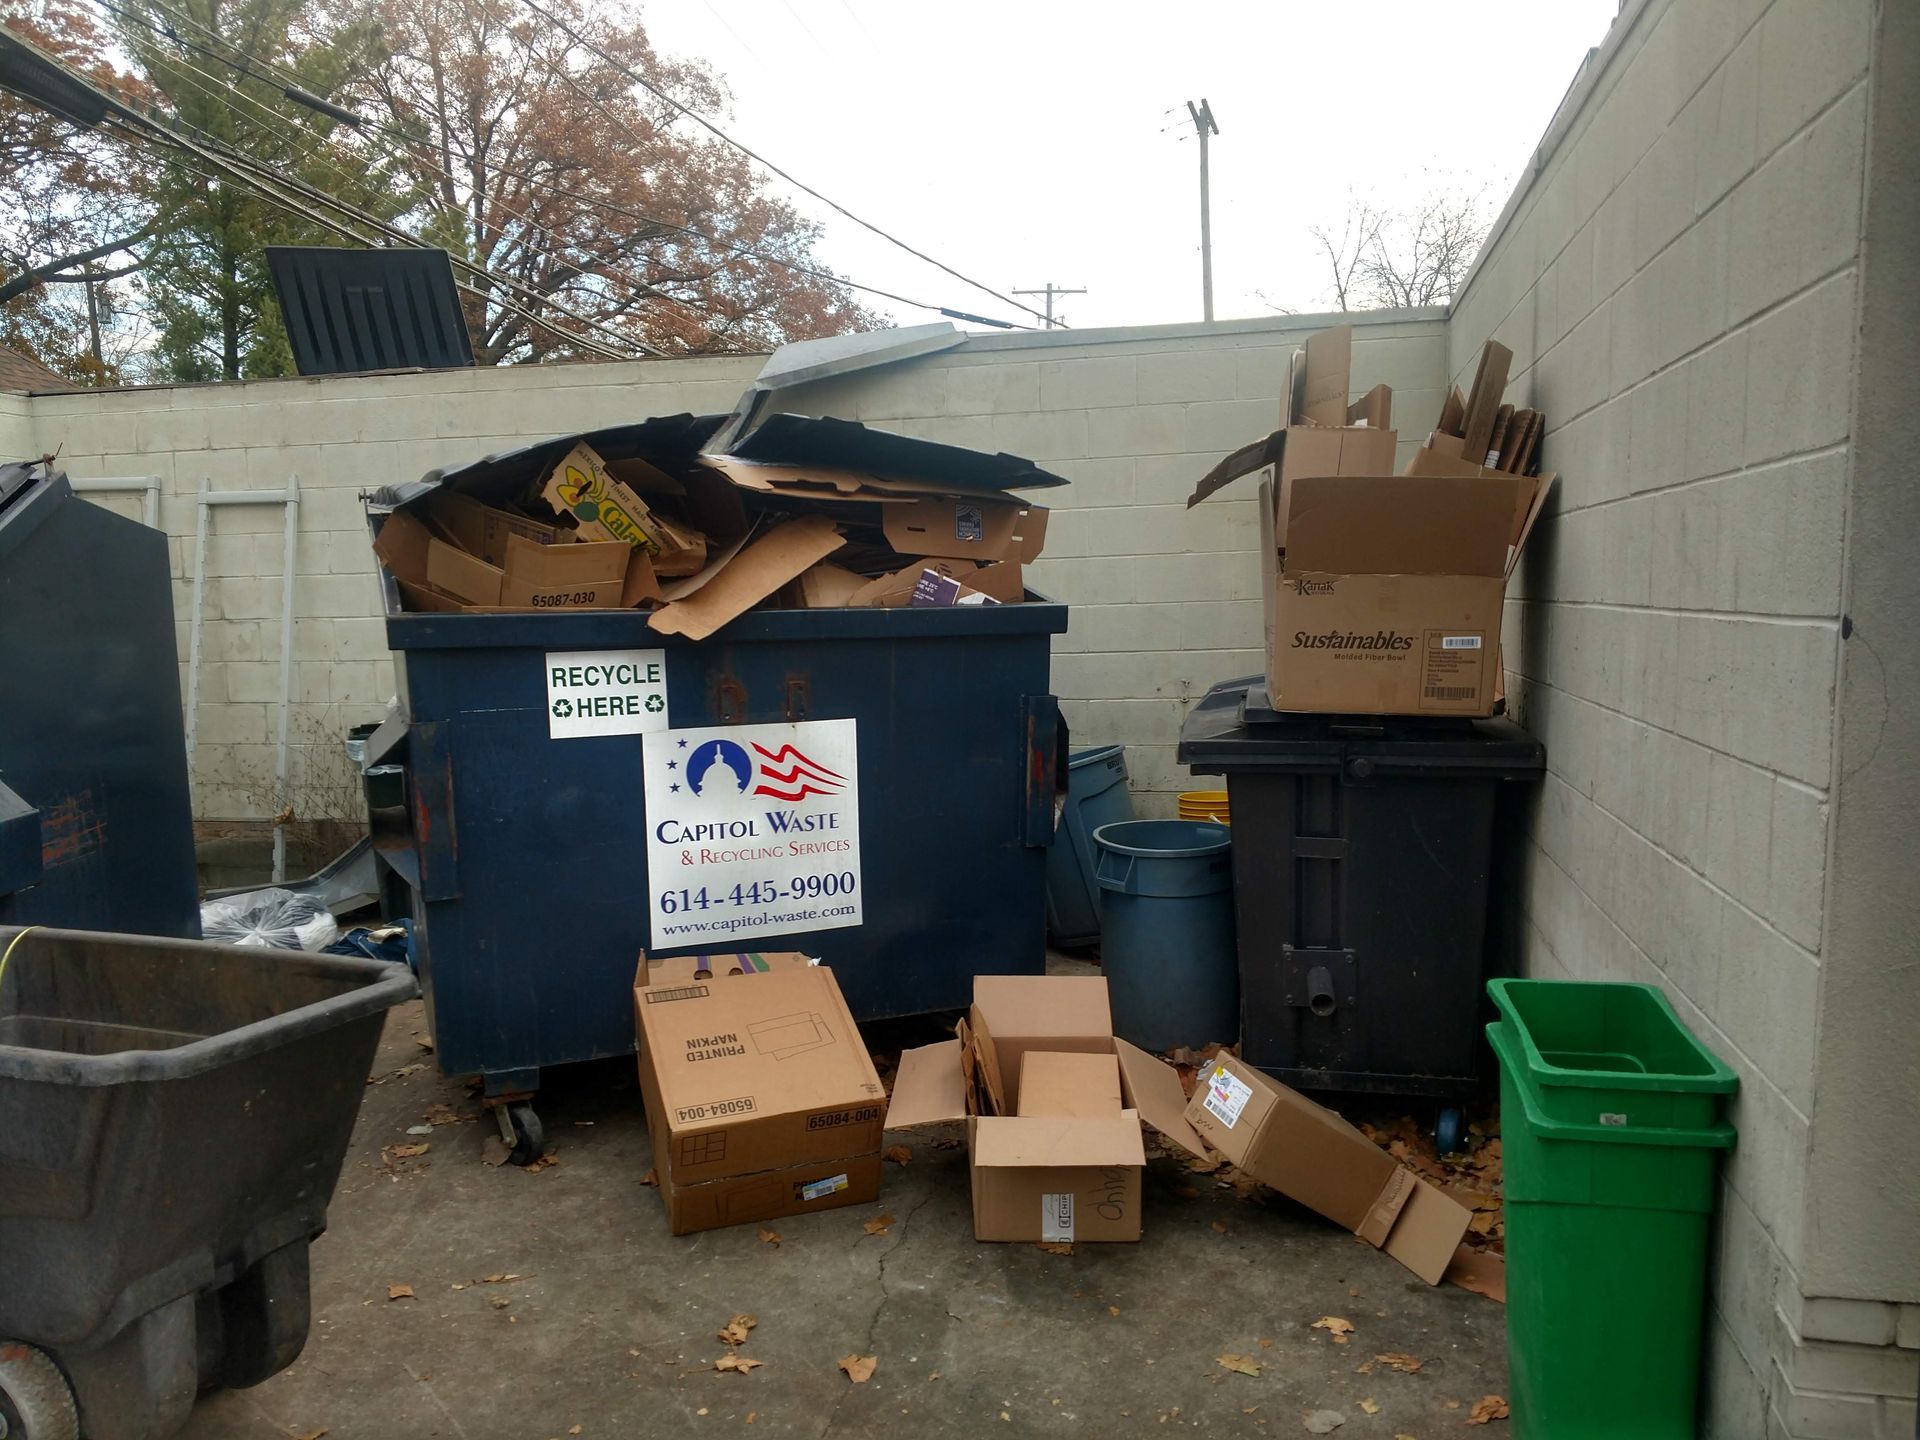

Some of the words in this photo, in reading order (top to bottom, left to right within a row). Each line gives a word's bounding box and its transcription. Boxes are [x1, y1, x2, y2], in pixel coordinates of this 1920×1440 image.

[611, 483, 631, 503] FINEST
[632, 505, 647, 521] HASS
[532, 591, 596, 607] 65087-030
[1291, 630, 1413, 650] Sustainables
[1334, 653, 1363, 661] Molded
[1365, 653, 1385, 661] Fiber
[551, 664, 661, 688] RECYCLE
[577, 695, 640, 718] HERE
[656, 819, 760, 845] CAPITOL
[765, 810, 840, 833] WASTE
[681, 850, 694, 866] &
[700, 846, 783, 865] RECYCLING
[789, 839, 850, 856] SERVICES
[660, 871, 856, 914] 614-445-9900
[662, 904, 856, 936] www.capitol-waste.com
[686, 1032, 738, 1050] NAPKIN
[686, 1044, 746, 1063] PRINTED
[679, 1098, 754, 1121] 65084-004
[809, 1106, 879, 1129] 65084-004
